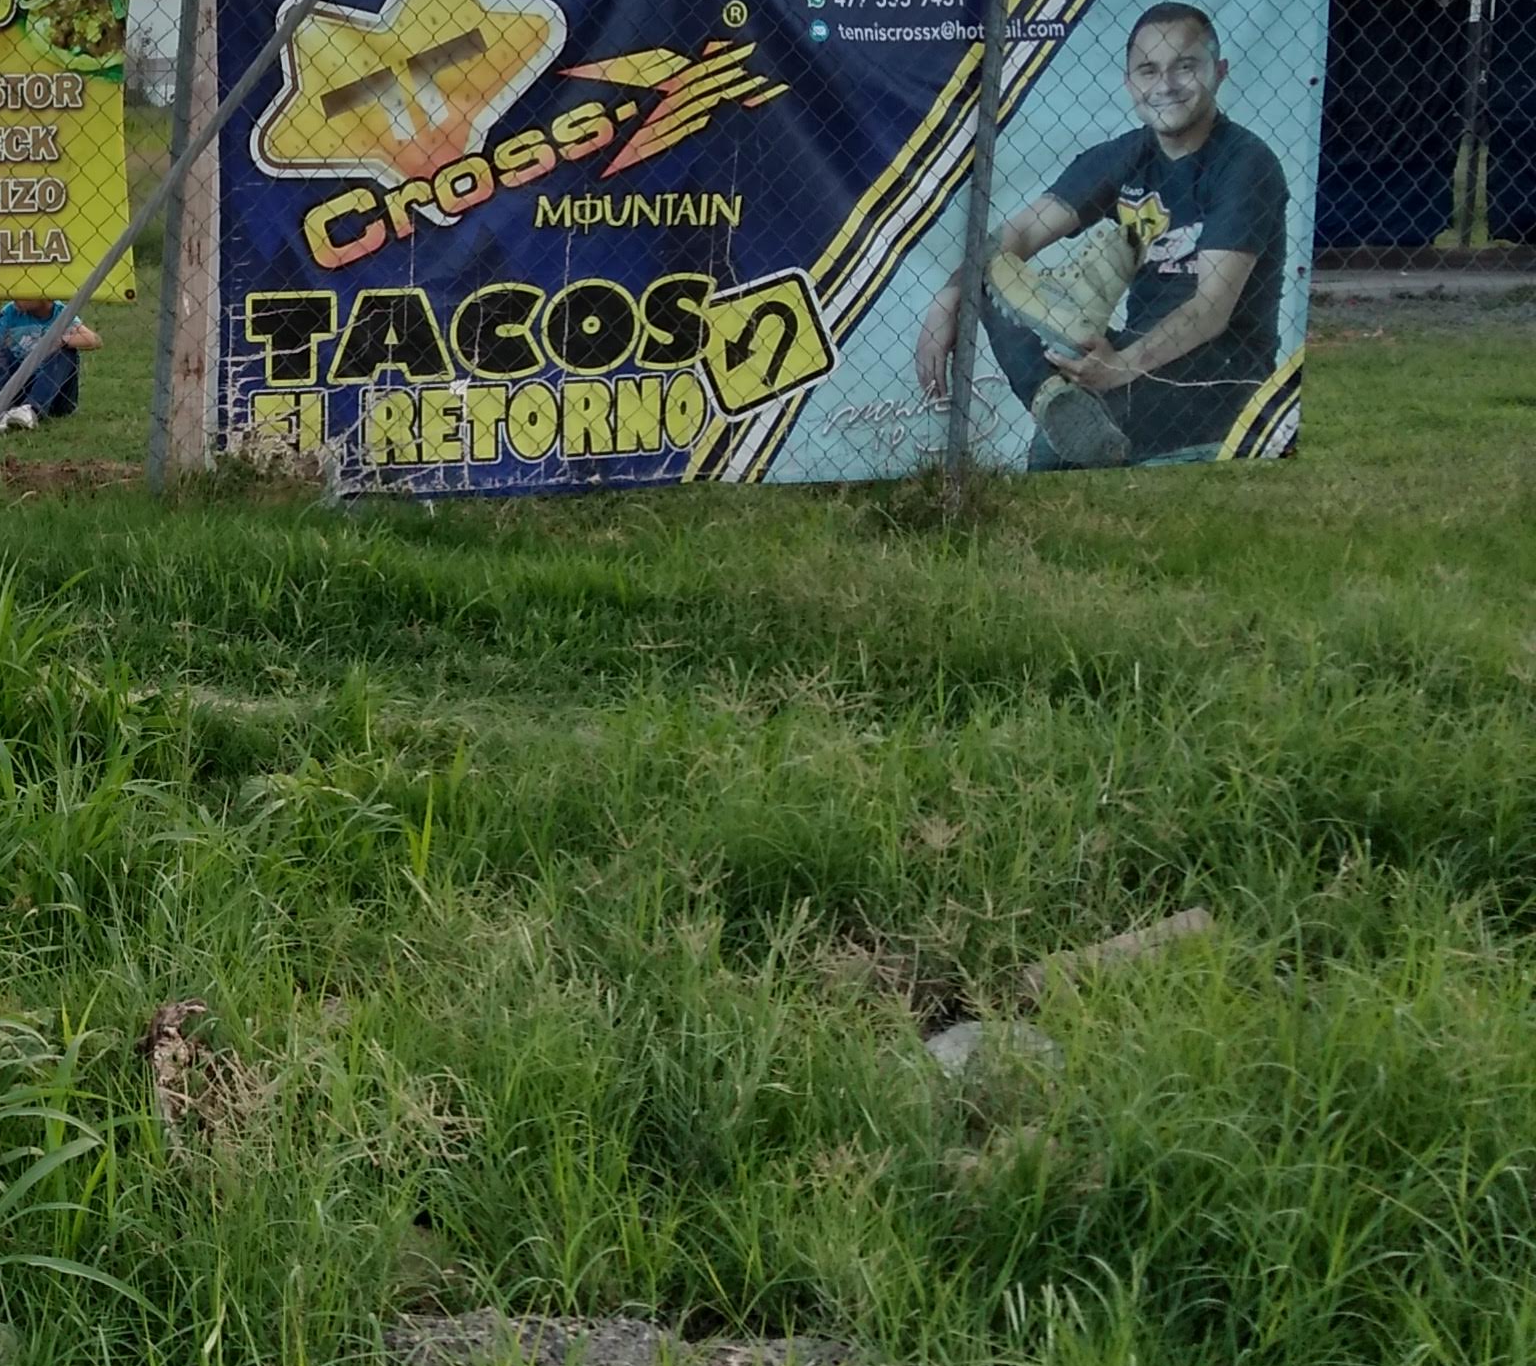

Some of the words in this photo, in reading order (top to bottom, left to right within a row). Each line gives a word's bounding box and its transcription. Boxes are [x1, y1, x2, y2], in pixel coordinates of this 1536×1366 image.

[838, 20, 1064, 42] tenniscrossx@hotail.com
[534, 194, 742, 234] MOUNTAIN
[245, 272, 716, 387] TACOS
[363, 369, 710, 465] RETORNO
